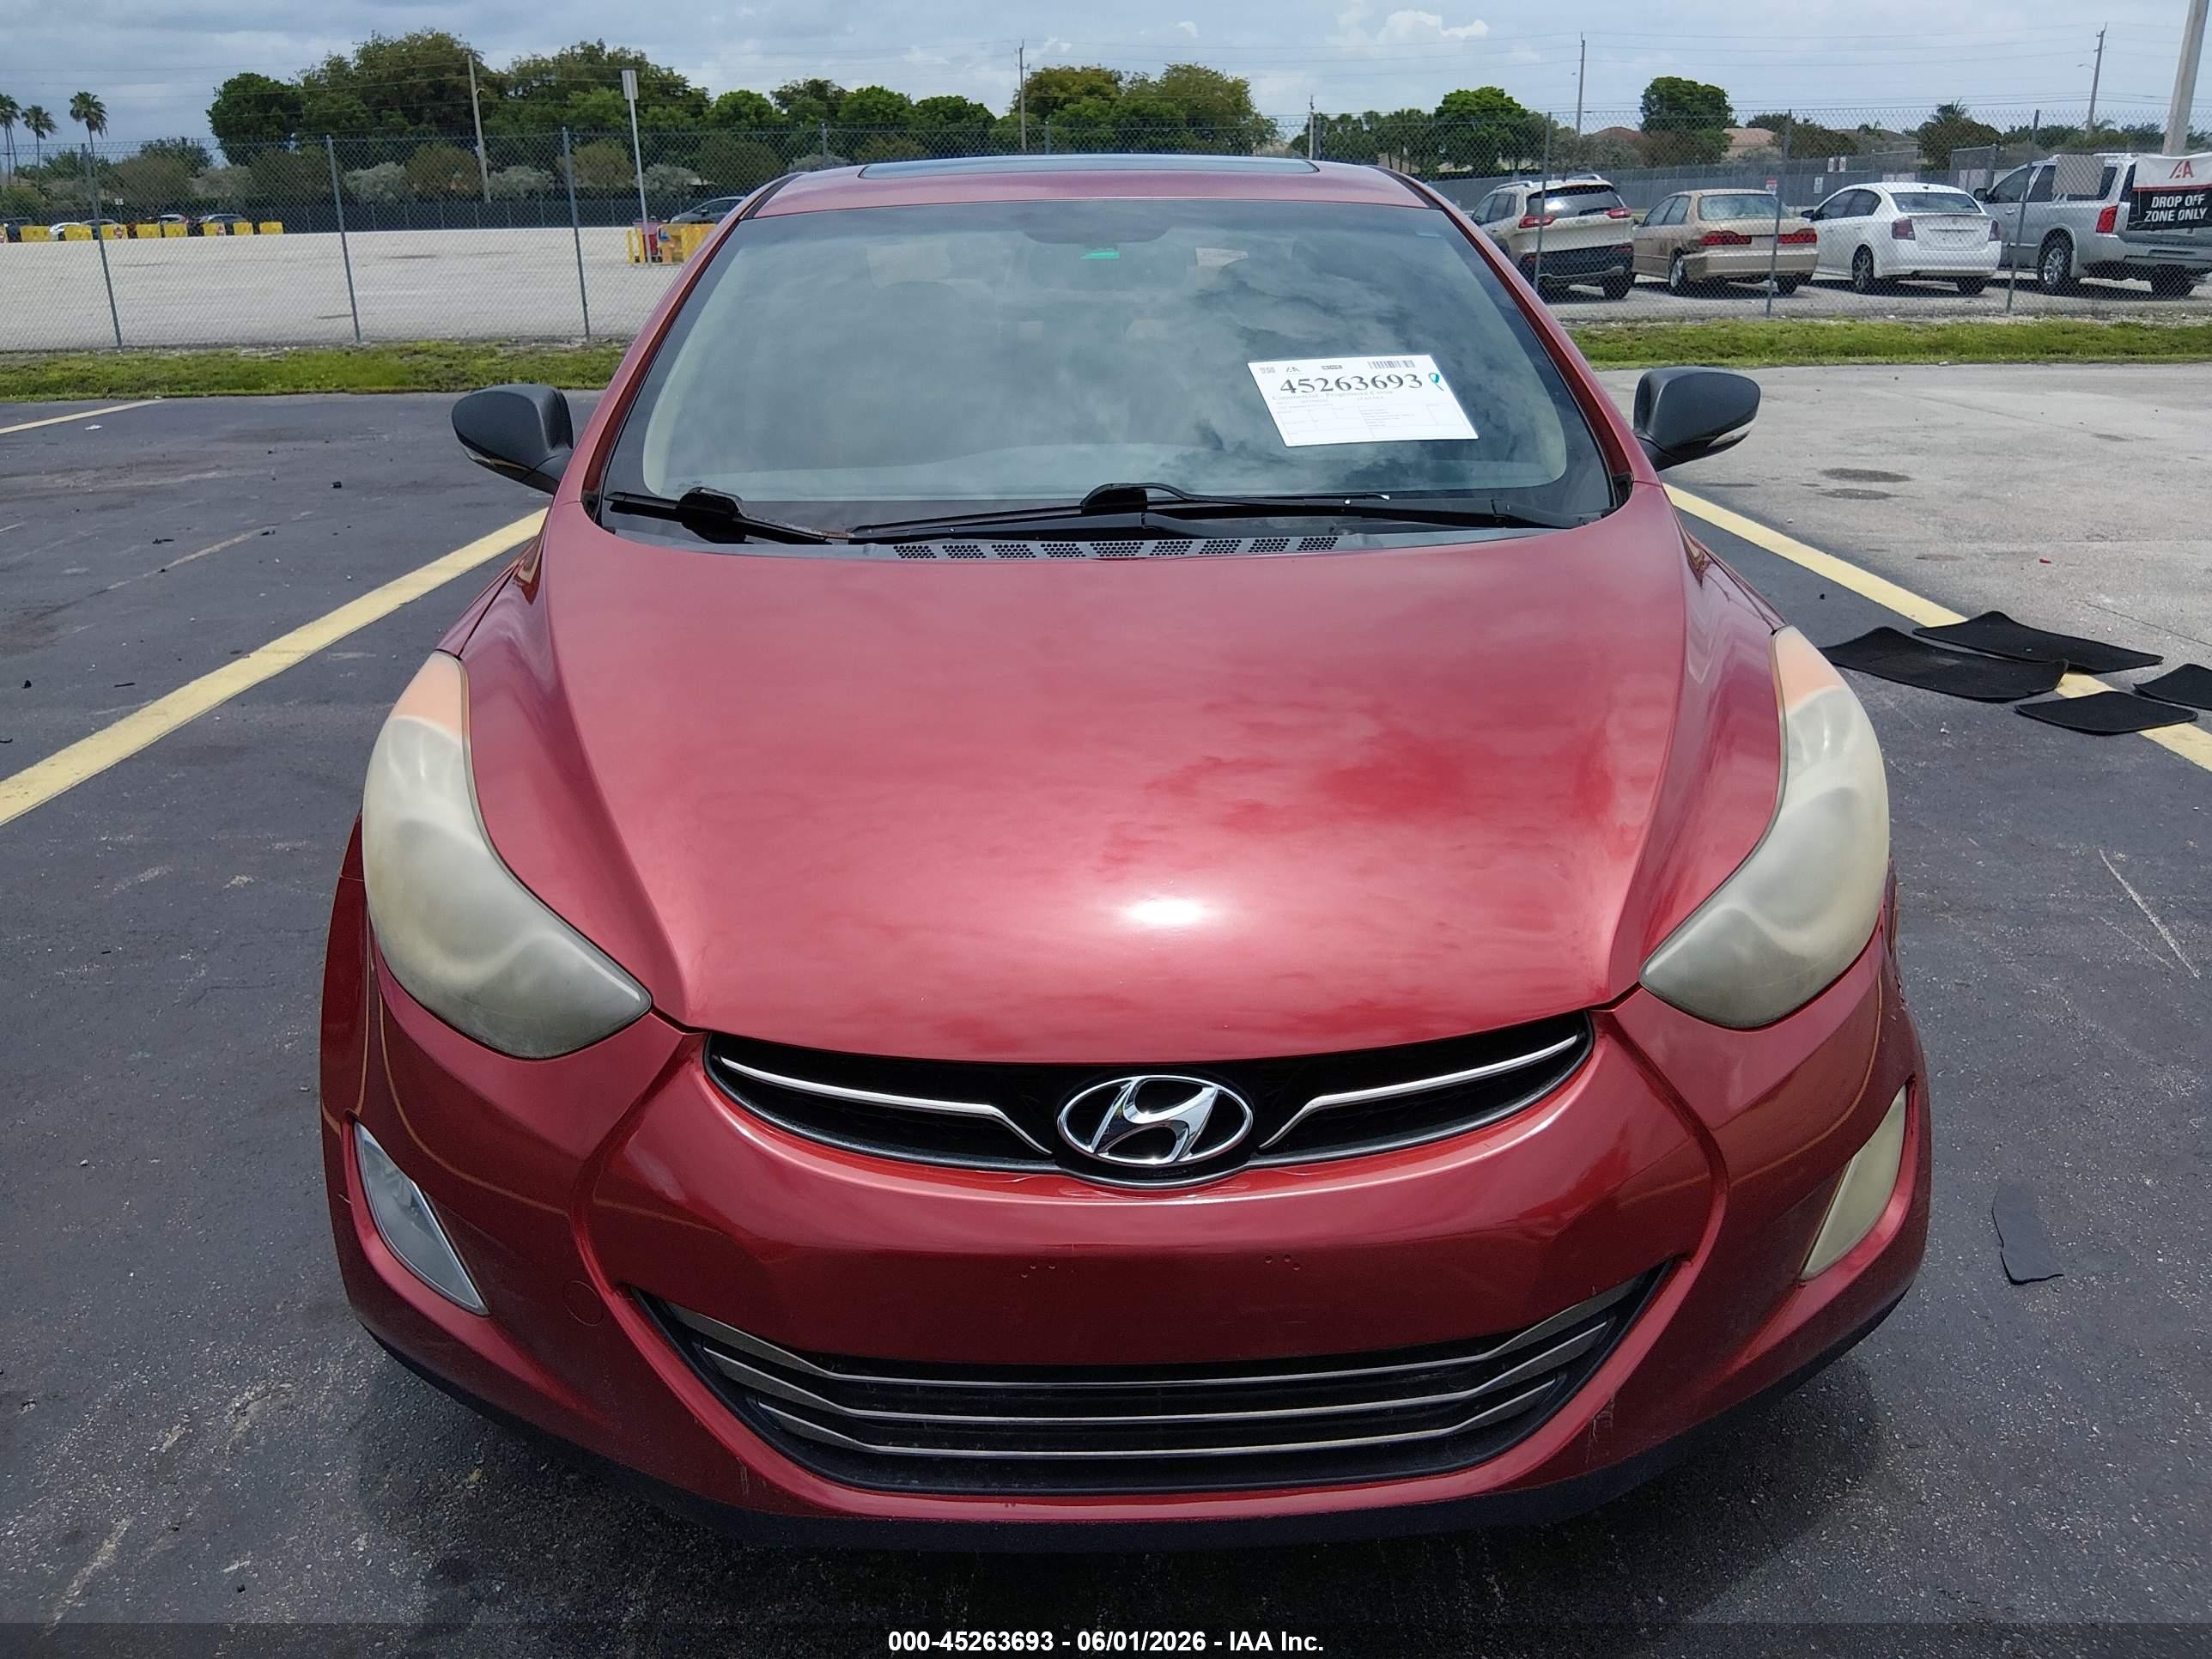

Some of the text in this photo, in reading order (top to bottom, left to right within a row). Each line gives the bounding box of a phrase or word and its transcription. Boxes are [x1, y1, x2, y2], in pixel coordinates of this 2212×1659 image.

[2151, 194, 2205, 208] DROP OFF
[2144, 207, 2208, 222] ZONE ONLY
[1279, 373, 1423, 394] 45263693
